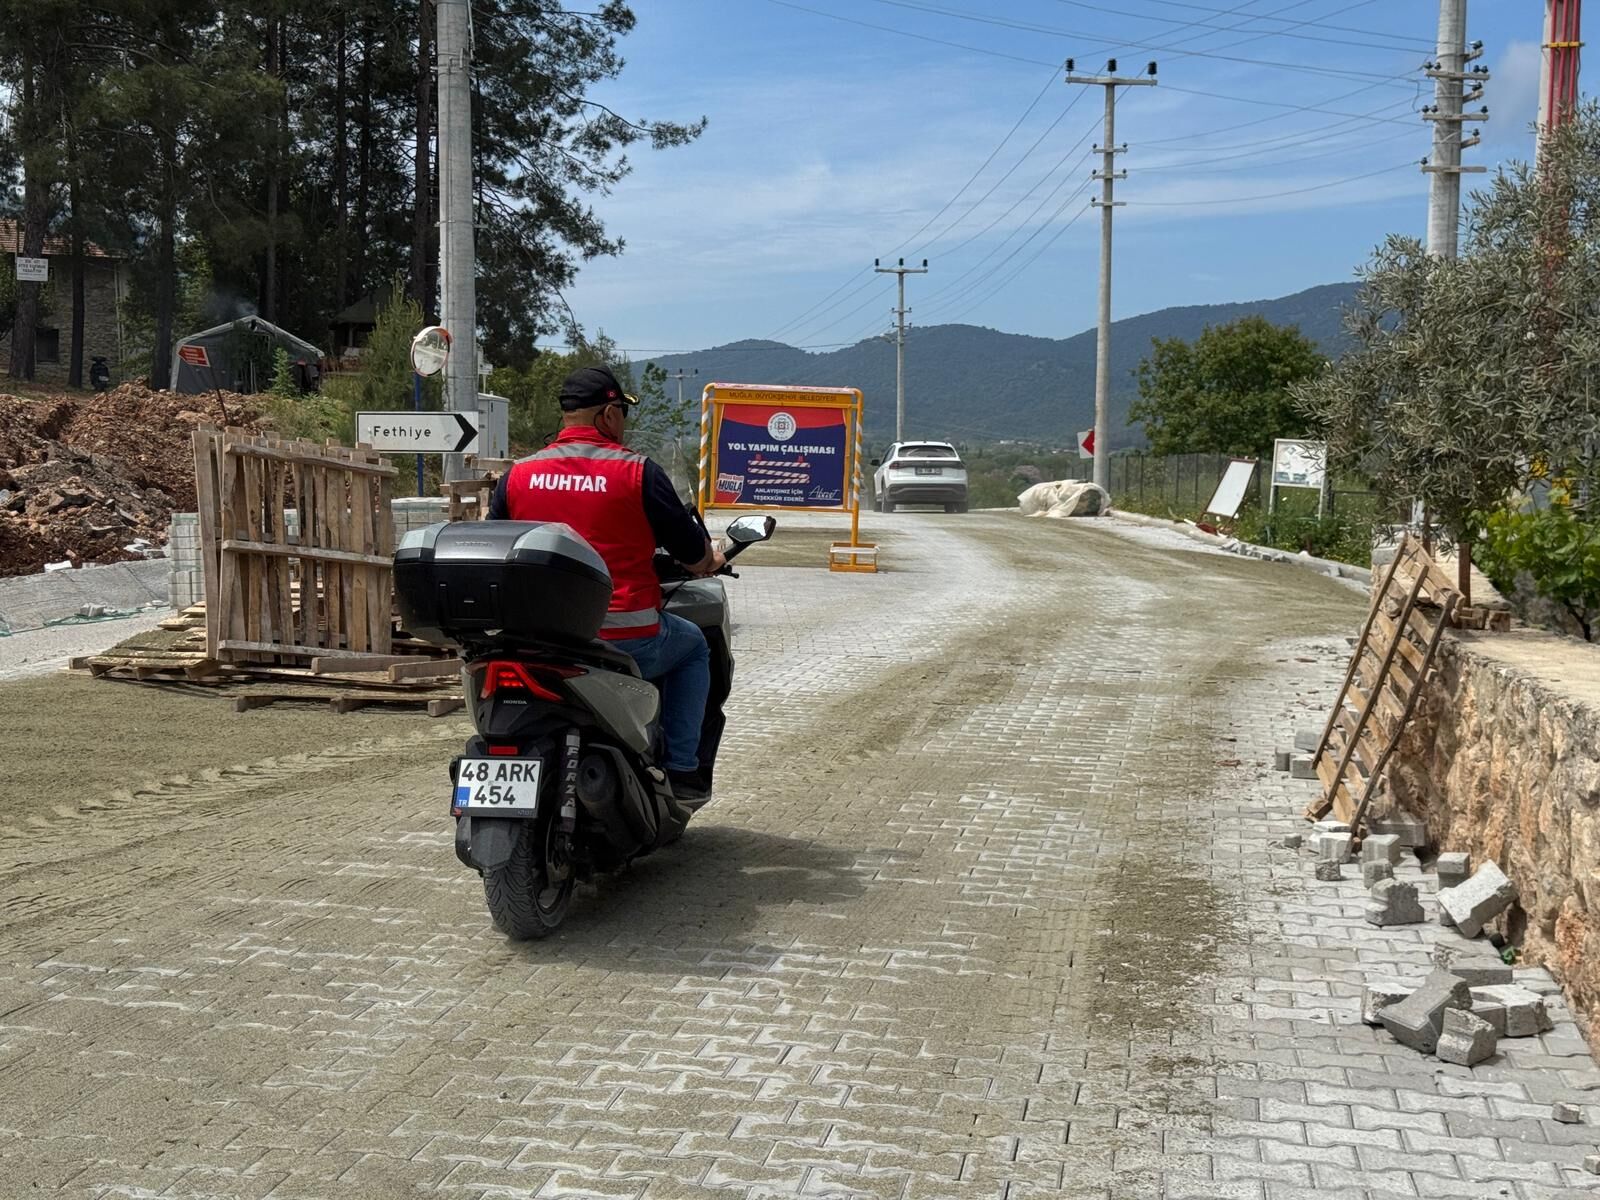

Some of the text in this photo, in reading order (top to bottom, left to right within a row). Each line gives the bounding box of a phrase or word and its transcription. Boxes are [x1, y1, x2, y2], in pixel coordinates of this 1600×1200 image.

[373, 425, 432, 440] Fethiye
[728, 442, 835, 456] YOL YAPIM ÇALIŞMASI
[529, 473, 607, 493] MUHTAR
[461, 762, 537, 783] 48 ARK
[565, 746, 579, 807] FORZA
[474, 785, 516, 805] 454
